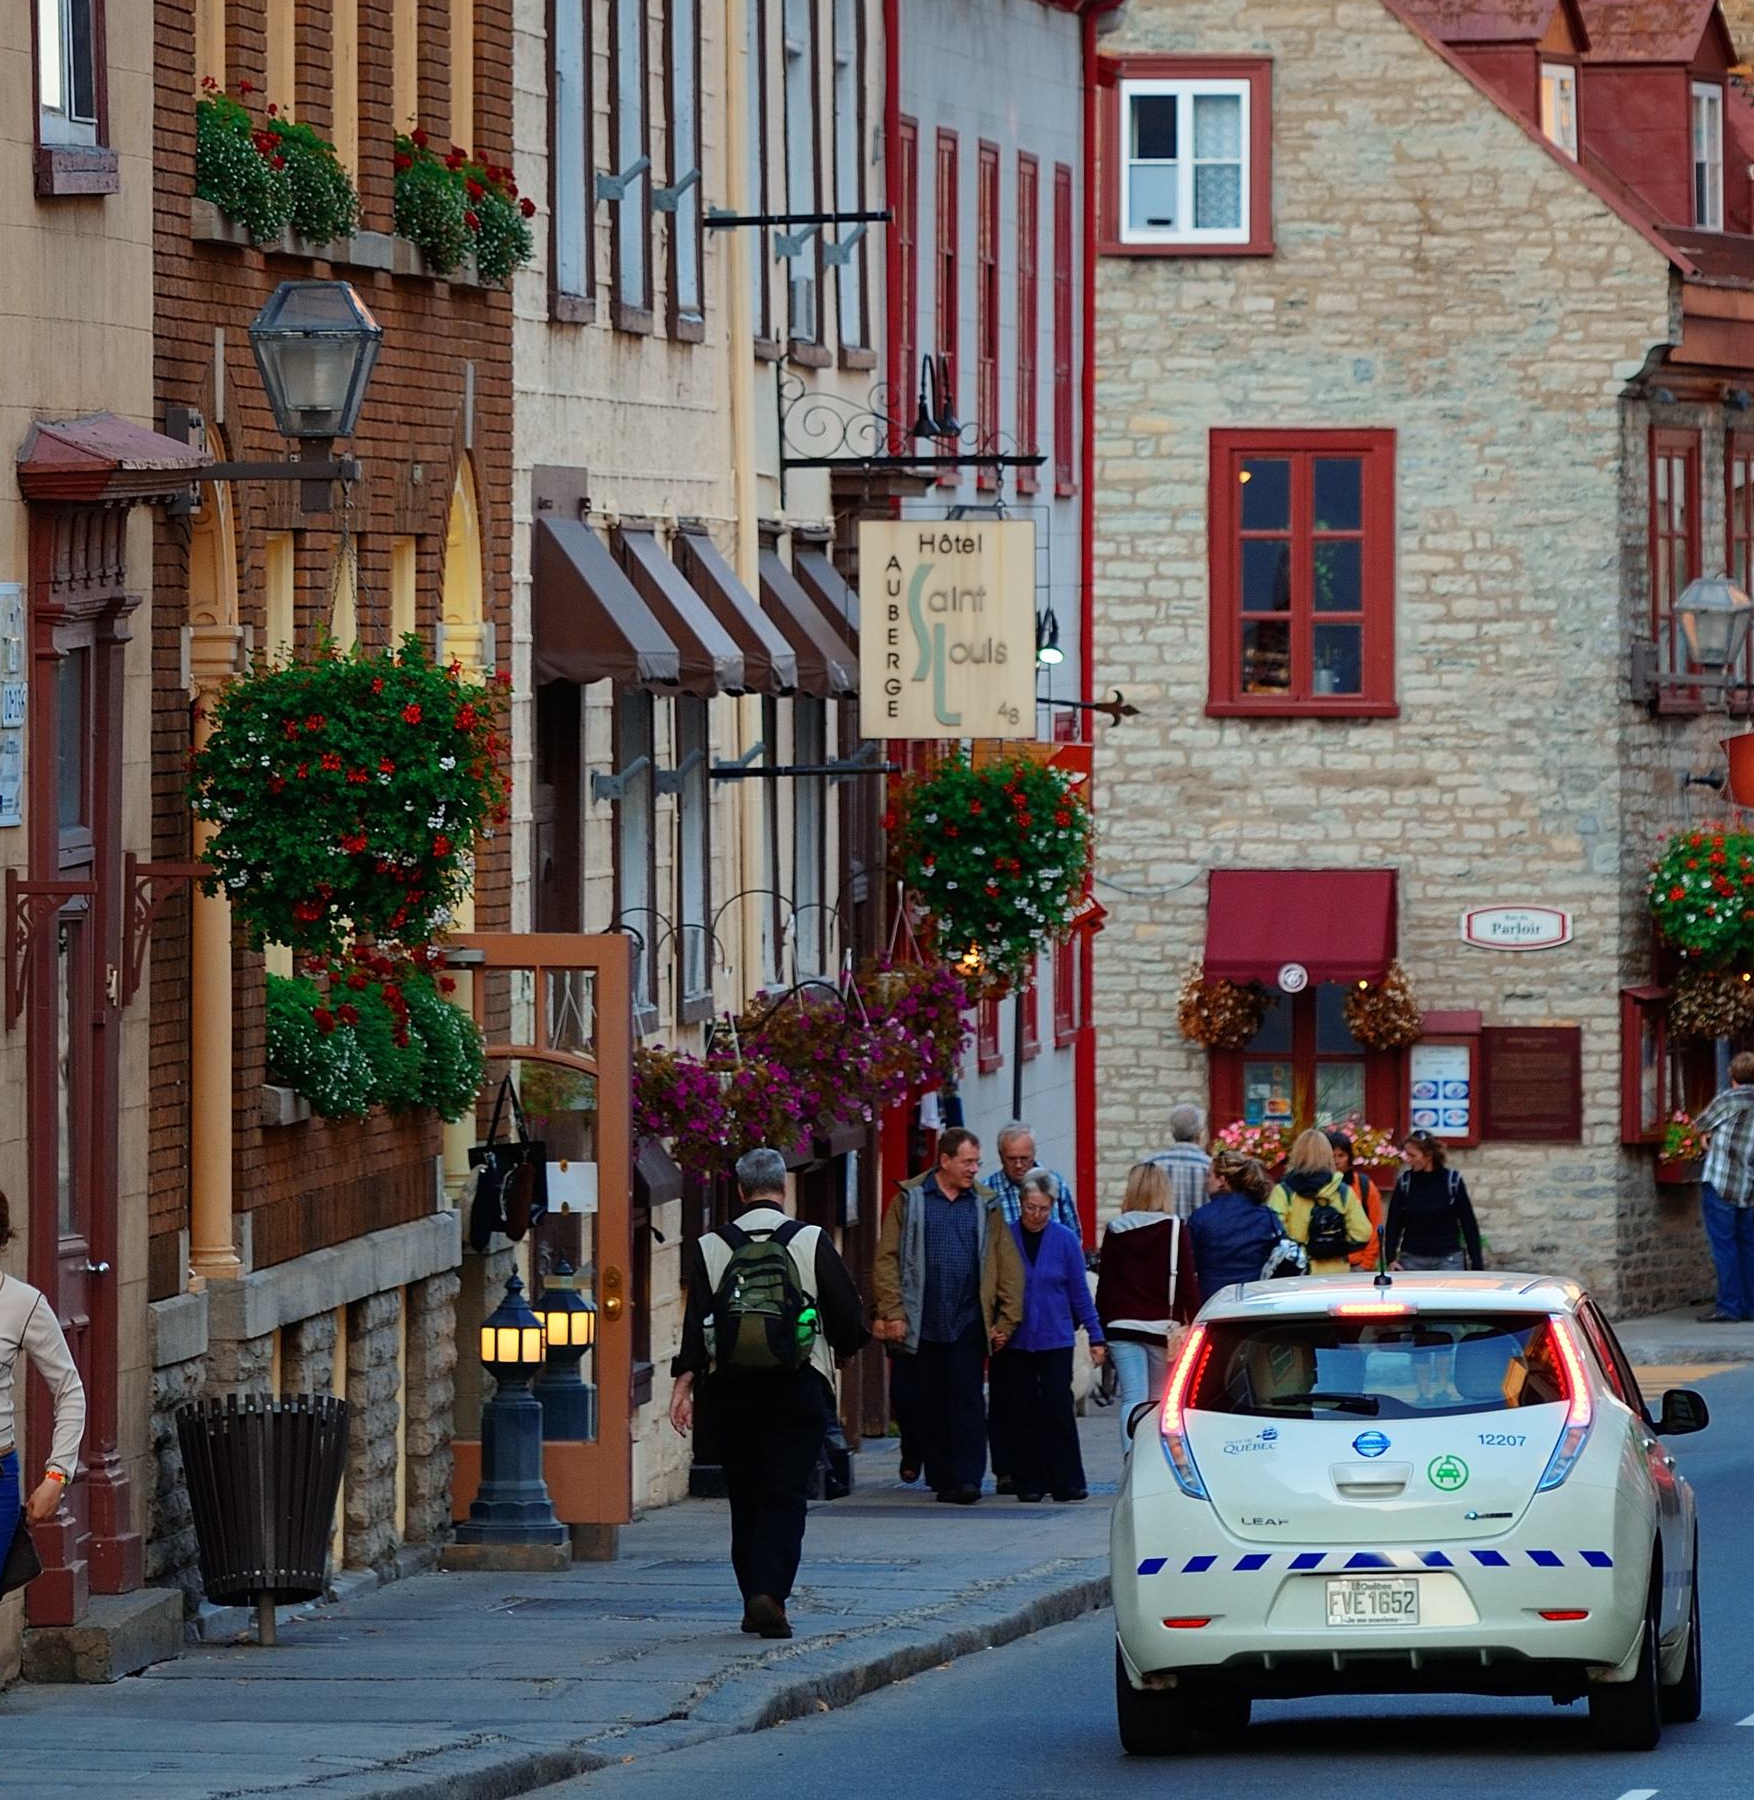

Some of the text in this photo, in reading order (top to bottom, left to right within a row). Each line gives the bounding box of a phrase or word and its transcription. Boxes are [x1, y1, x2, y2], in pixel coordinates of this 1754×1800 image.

[919, 533, 982, 555] Hôtel
[908, 563, 987, 682] Saint
[884, 555, 903, 719] AUBERGE
[933, 623, 1009, 726] Louis
[997, 701, 1020, 725] 48
[1492, 922, 1542, 935] Parloir
[1223, 1441, 1277, 1455] QUÉBEC
[1478, 1434, 1527, 1447] 12207
